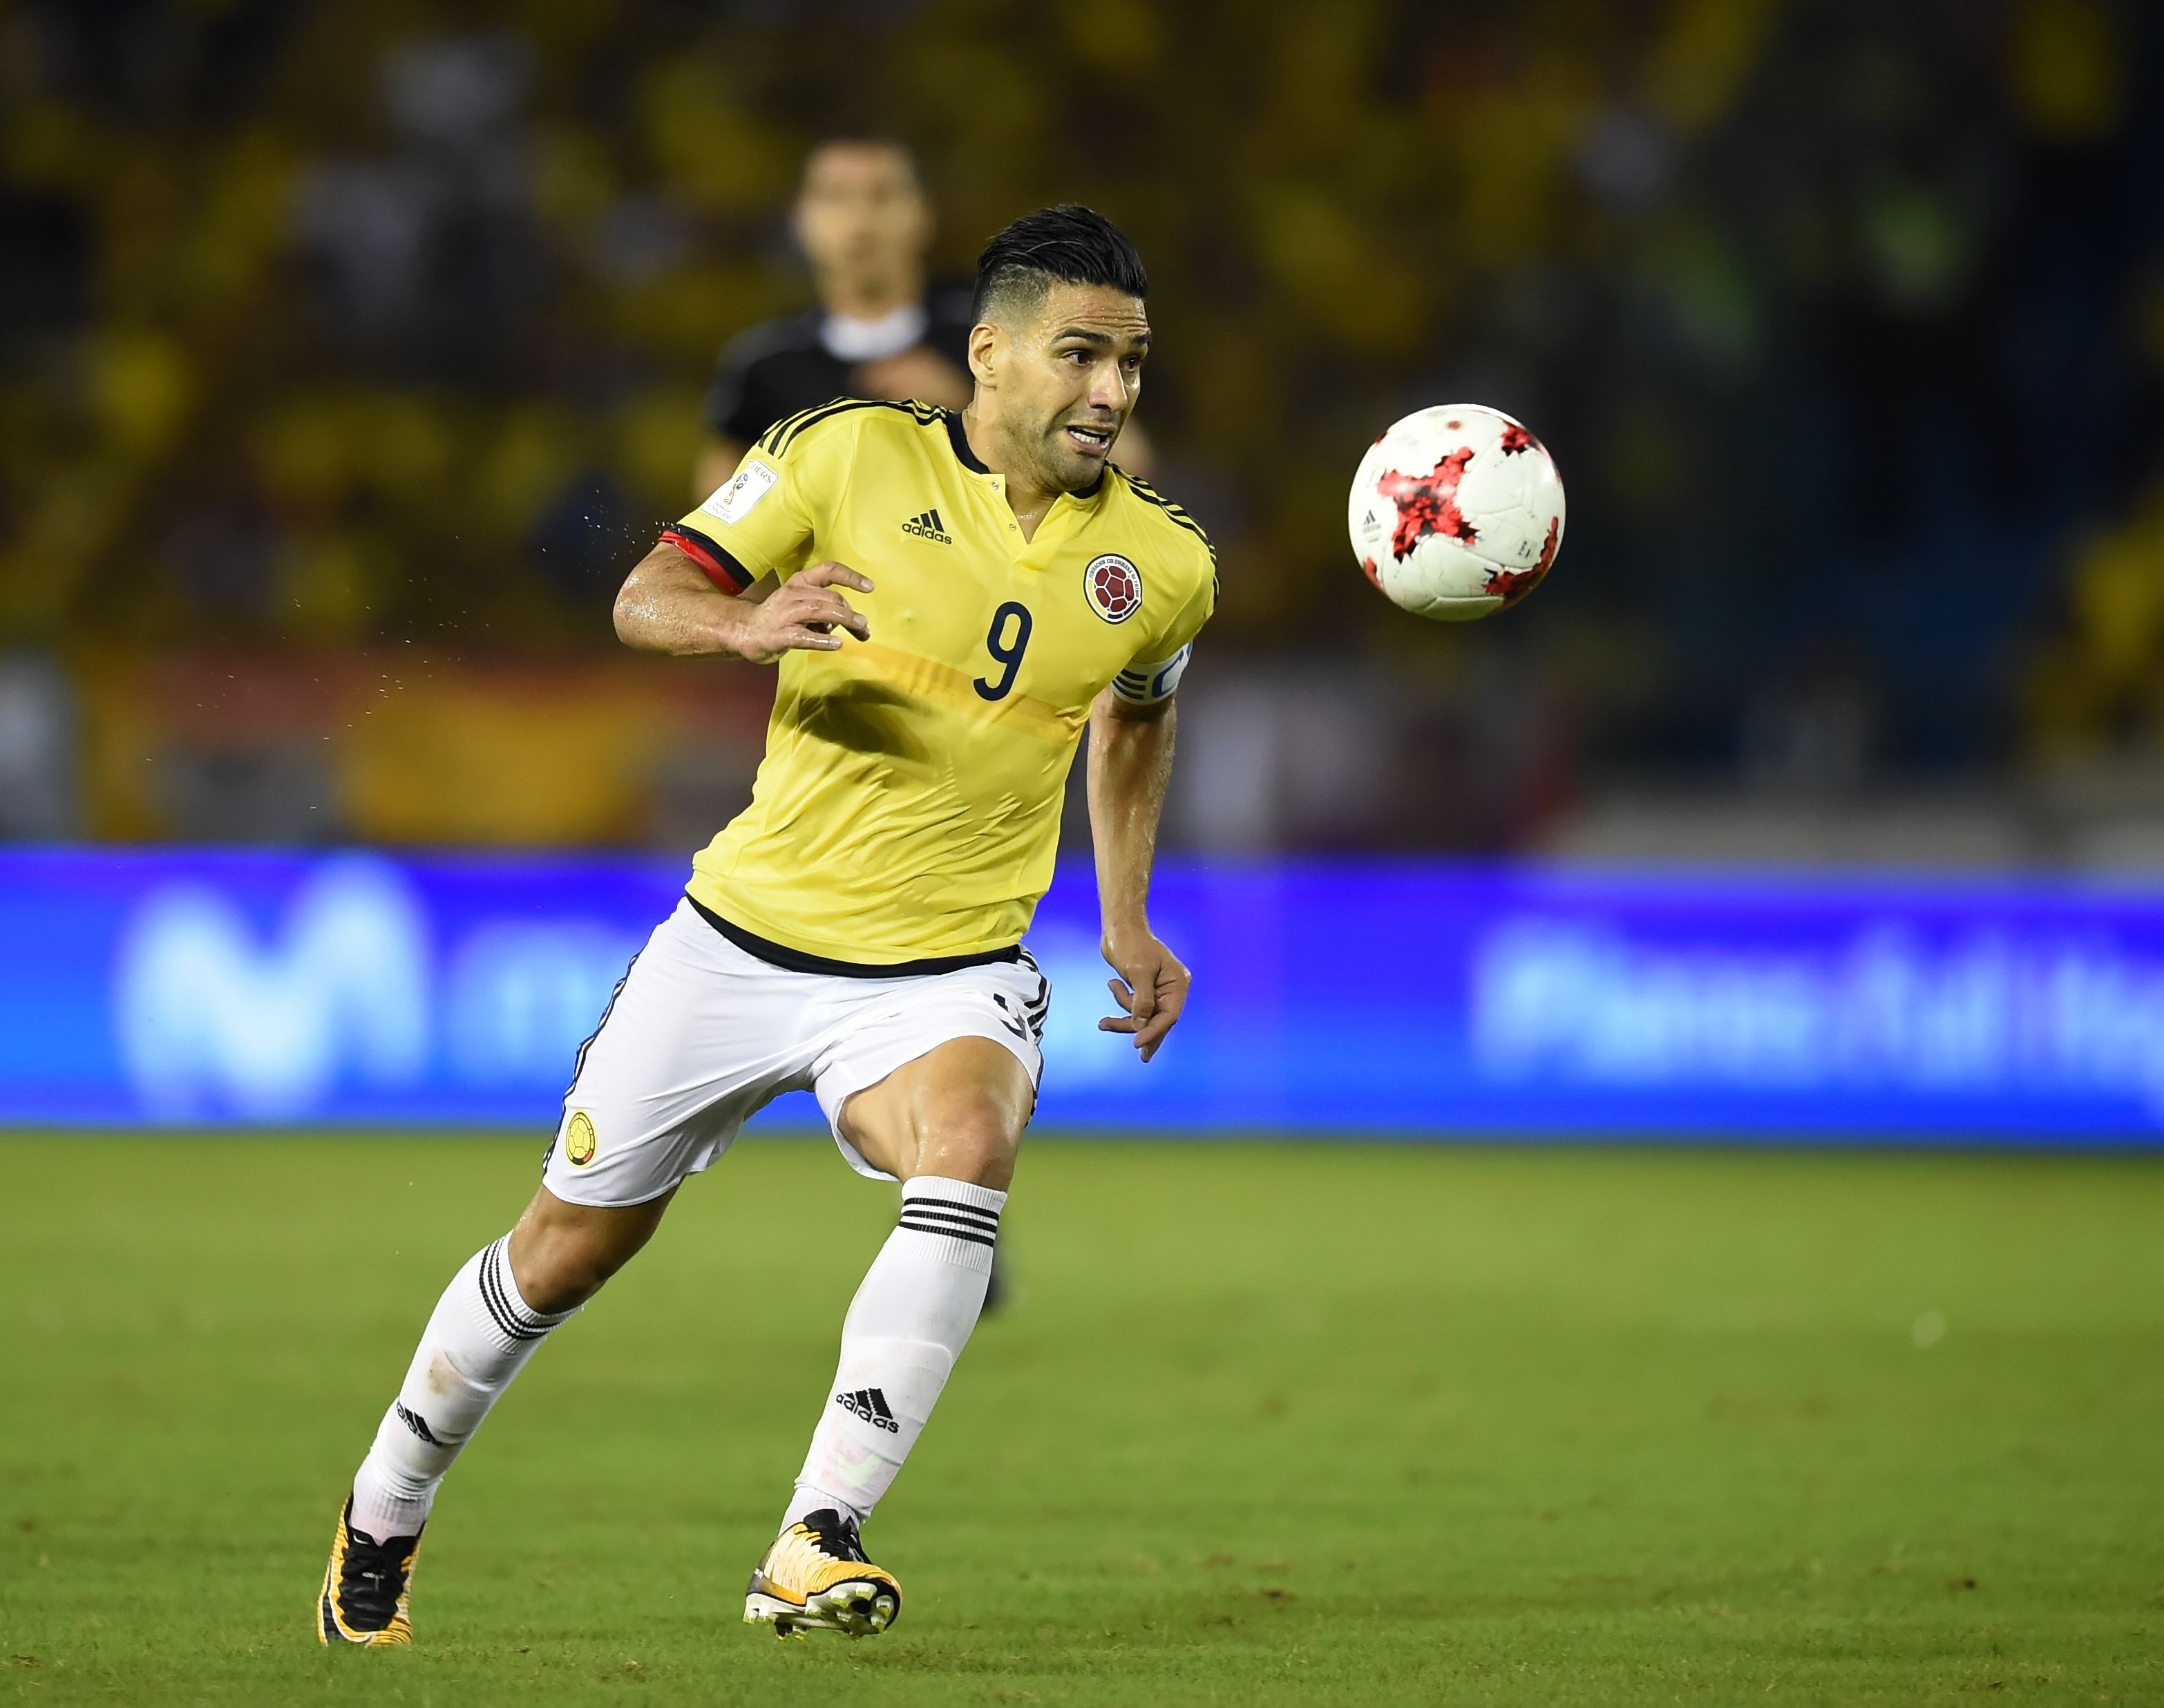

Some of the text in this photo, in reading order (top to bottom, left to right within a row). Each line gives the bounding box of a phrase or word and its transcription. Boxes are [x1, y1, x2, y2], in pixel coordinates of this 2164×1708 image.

[902, 523, 952, 544] adidas
[973, 601, 1032, 701] 9
[836, 1394, 900, 1434] adidas
